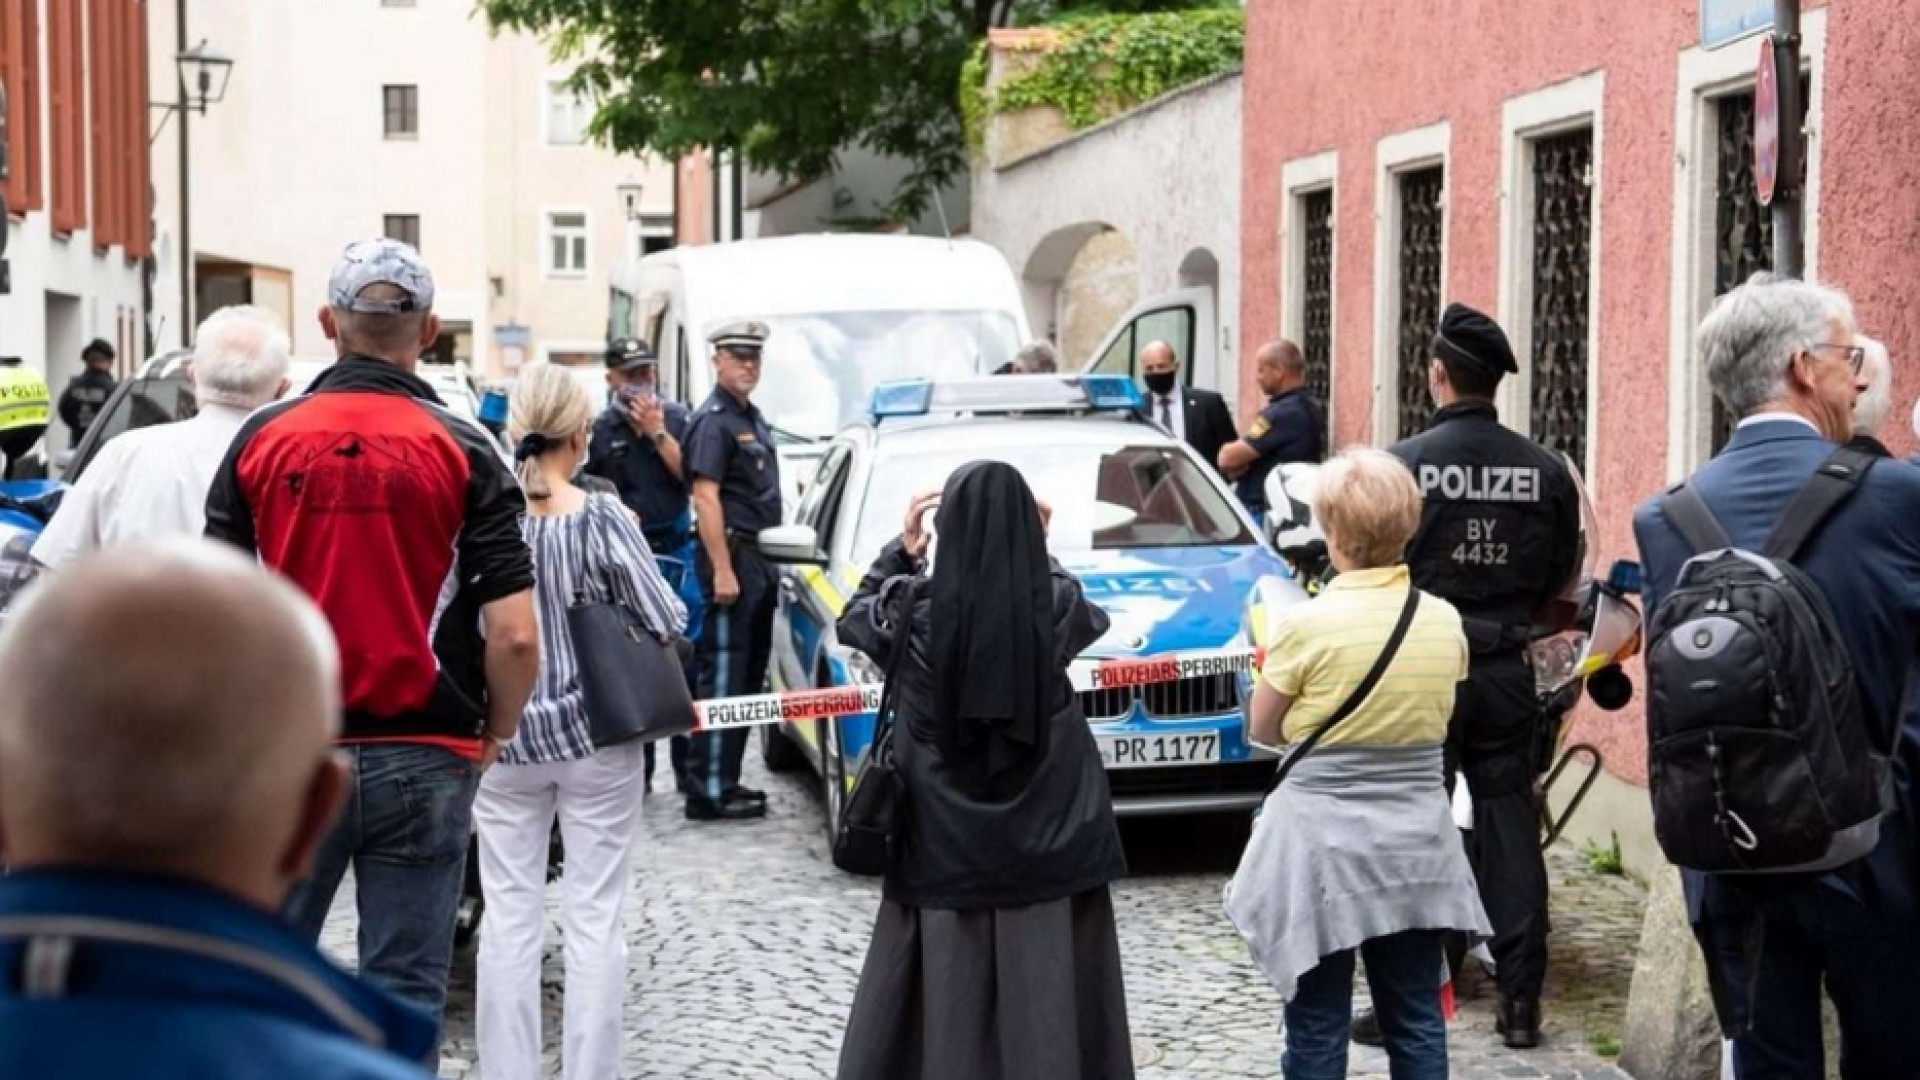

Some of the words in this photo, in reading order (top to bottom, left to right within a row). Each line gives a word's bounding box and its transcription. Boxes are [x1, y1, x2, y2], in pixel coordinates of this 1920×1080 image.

[1419, 464, 1540, 502] POLIZEI
[1467, 518, 1497, 541] BY
[1451, 542, 1508, 565] 4432
[1081, 578, 1213, 593] LIZEI
[1114, 737, 1147, 763] PR
[1153, 735, 1216, 762] 1177
